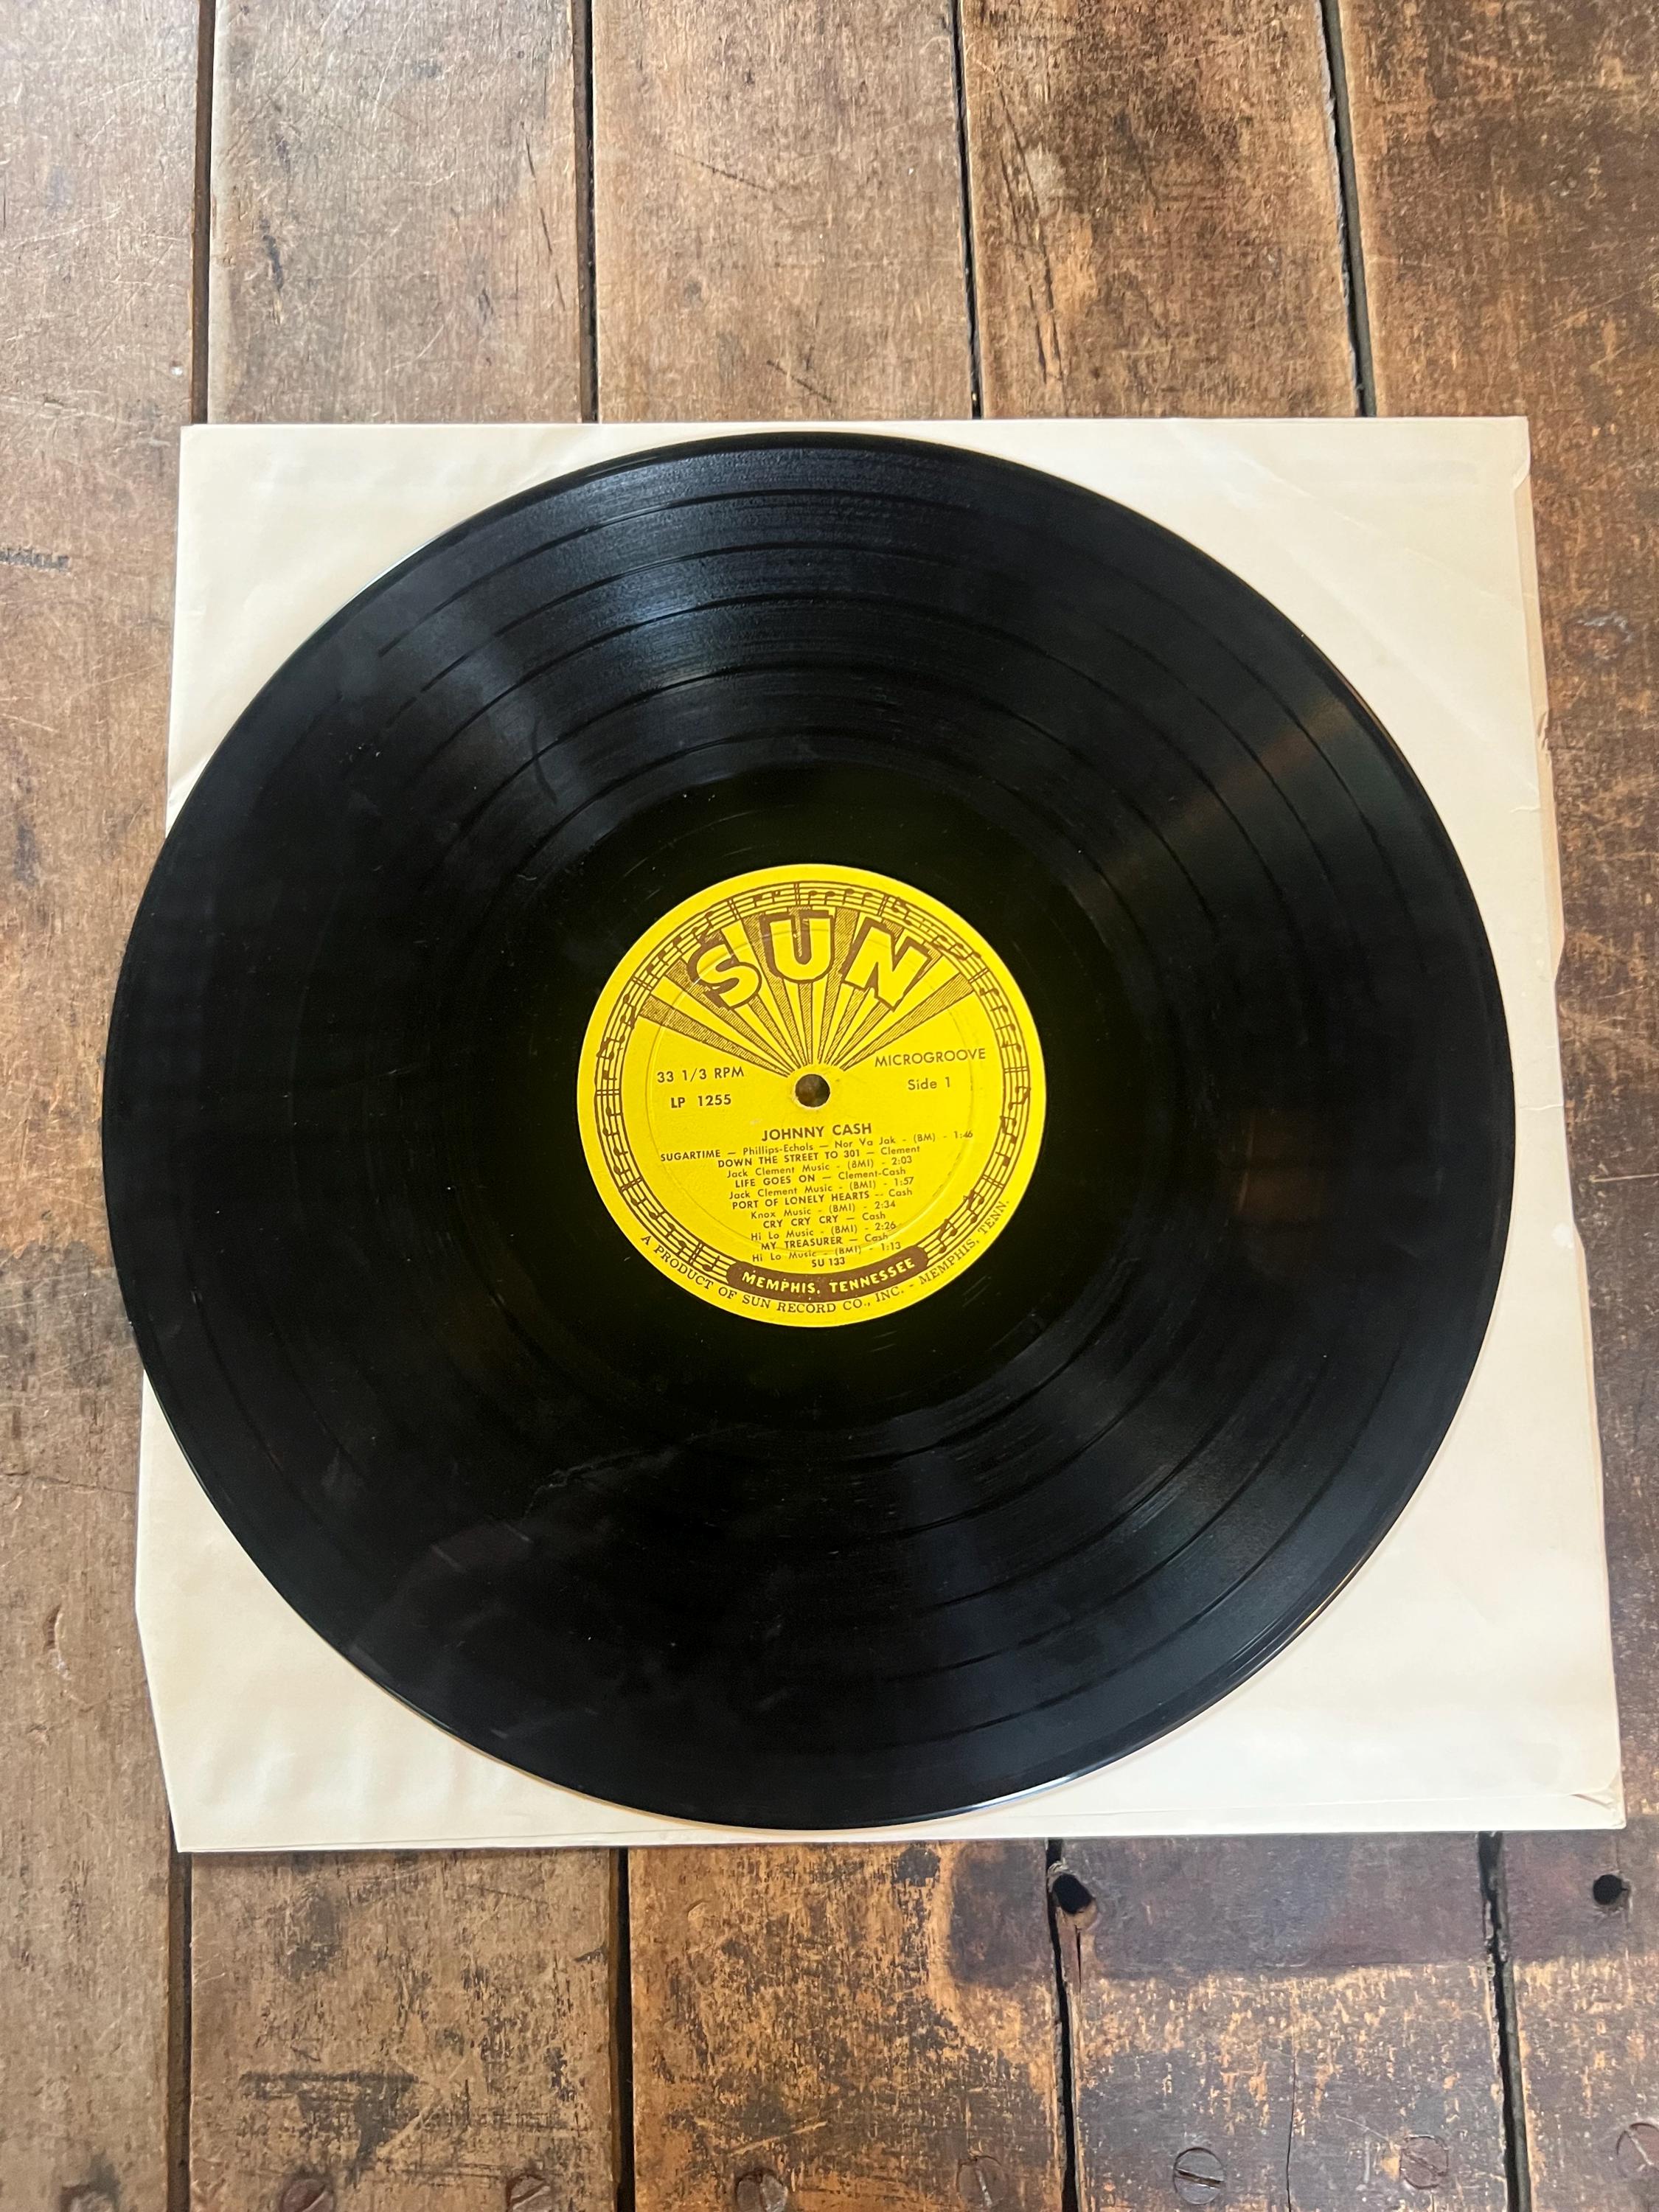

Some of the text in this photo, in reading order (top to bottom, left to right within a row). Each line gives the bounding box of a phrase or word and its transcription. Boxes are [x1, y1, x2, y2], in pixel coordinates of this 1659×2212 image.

[687, 909, 933, 1012] SUN
[874, 1048, 987, 1068] MICROGROOVE
[656, 1065, 745, 1083] 33 1/3 RPM
[908, 1077, 951, 1091] Side 1
[670, 1093, 732, 1109] LP 1255
[761, 1123, 872, 1142] JOHNNY CASH
[660, 1150, 721, 1162] SUGARTIME
[742, 1142, 814, 1156] Phillips-Echols
[835, 1140, 852, 1149] Nor
[859, 1138, 873, 1147] Va
[879, 1136, 896, 1145] Jak
[953, 1130, 973, 1139] 1:46
[717, 1158, 753, 1169] DOWN
[758, 1155, 779, 1165] THE
[784, 1152, 818, 1163] STREET
[824, 1150, 838, 1159] TO
[844, 1149, 860, 1158] 301
[880, 1146, 920, 1155] Clement
[726, 1169, 748, 1178] Jack
[755, 1166, 795, 1176] Clement
[801, 1163, 830, 1172] Music
[847, 1159, 874, 1170] (BMI)
[891, 1155, 913, 1166] 2:03
[734, 1178, 756, 1188] LIFE
[762, 1175, 791, 1186] GOES
[799, 1173, 815, 1183] ON
[838, 1167, 906, 1180] Clement-Cash
[728, 1191, 751, 1200] Jack
[757, 1187, 798, 1197] Clement
[804, 1184, 833, 1194] Music
[849, 1180, 876, 1192] (BMI)
[894, 1177, 914, 1186] 1:57
[732, 1200, 759, 1210] PORT
[765, 1198, 779, 1207] OF
[785, 1194, 825, 1206] LONELY
[831, 1191, 870, 1201] HEARTS
[888, 1188, 913, 1197] Cash
[751, 1211, 776, 1220] Knox
[784, 1207, 812, 1217] Music
[829, 1203, 855, 1213] (BMI)
[874, 1200, 896, 1210] 2:34
[762, 1220, 783, 1228] CRY
[790, 1217, 811, 1227] CRY
[819, 1214, 839, 1225] CRY
[862, 1211, 886, 1221] Cash
[751, 1232, 762, 1241] Hi
[768, 1231, 779, 1239] Lo
[786, 1227, 814, 1238] Music
[831, 1224, 858, 1236] (BMI)
[874, 1221, 897, 1231] 2:26
[752, 1253, 762, 1262] Hi
[771, 1251, 782, 1261] Lo
[789, 1249, 816, 1259] Music
[835, 1245, 861, 1256] (BMI)
[880, 1241, 901, 1251] 1:13
[761, 1242, 777, 1251] MY
[784, 1236, 844, 1249] TREASURER
[864, 1233, 888, 1242] Cash
[641, 1235, 652, 1245] A
[654, 1246, 714, 1290] PRODUCT
[718, 1286, 737, 1299] OF
[742, 1294, 771, 1309] SUN
[776, 1301, 836, 1314] RECORD
[874, 1286, 905, 1302] INC.
[978, 1200, 1009, 1235] TENN.
[811, 1256, 846, 1267] SU 133
[829, 1257, 916, 1293] TENNESSEE
